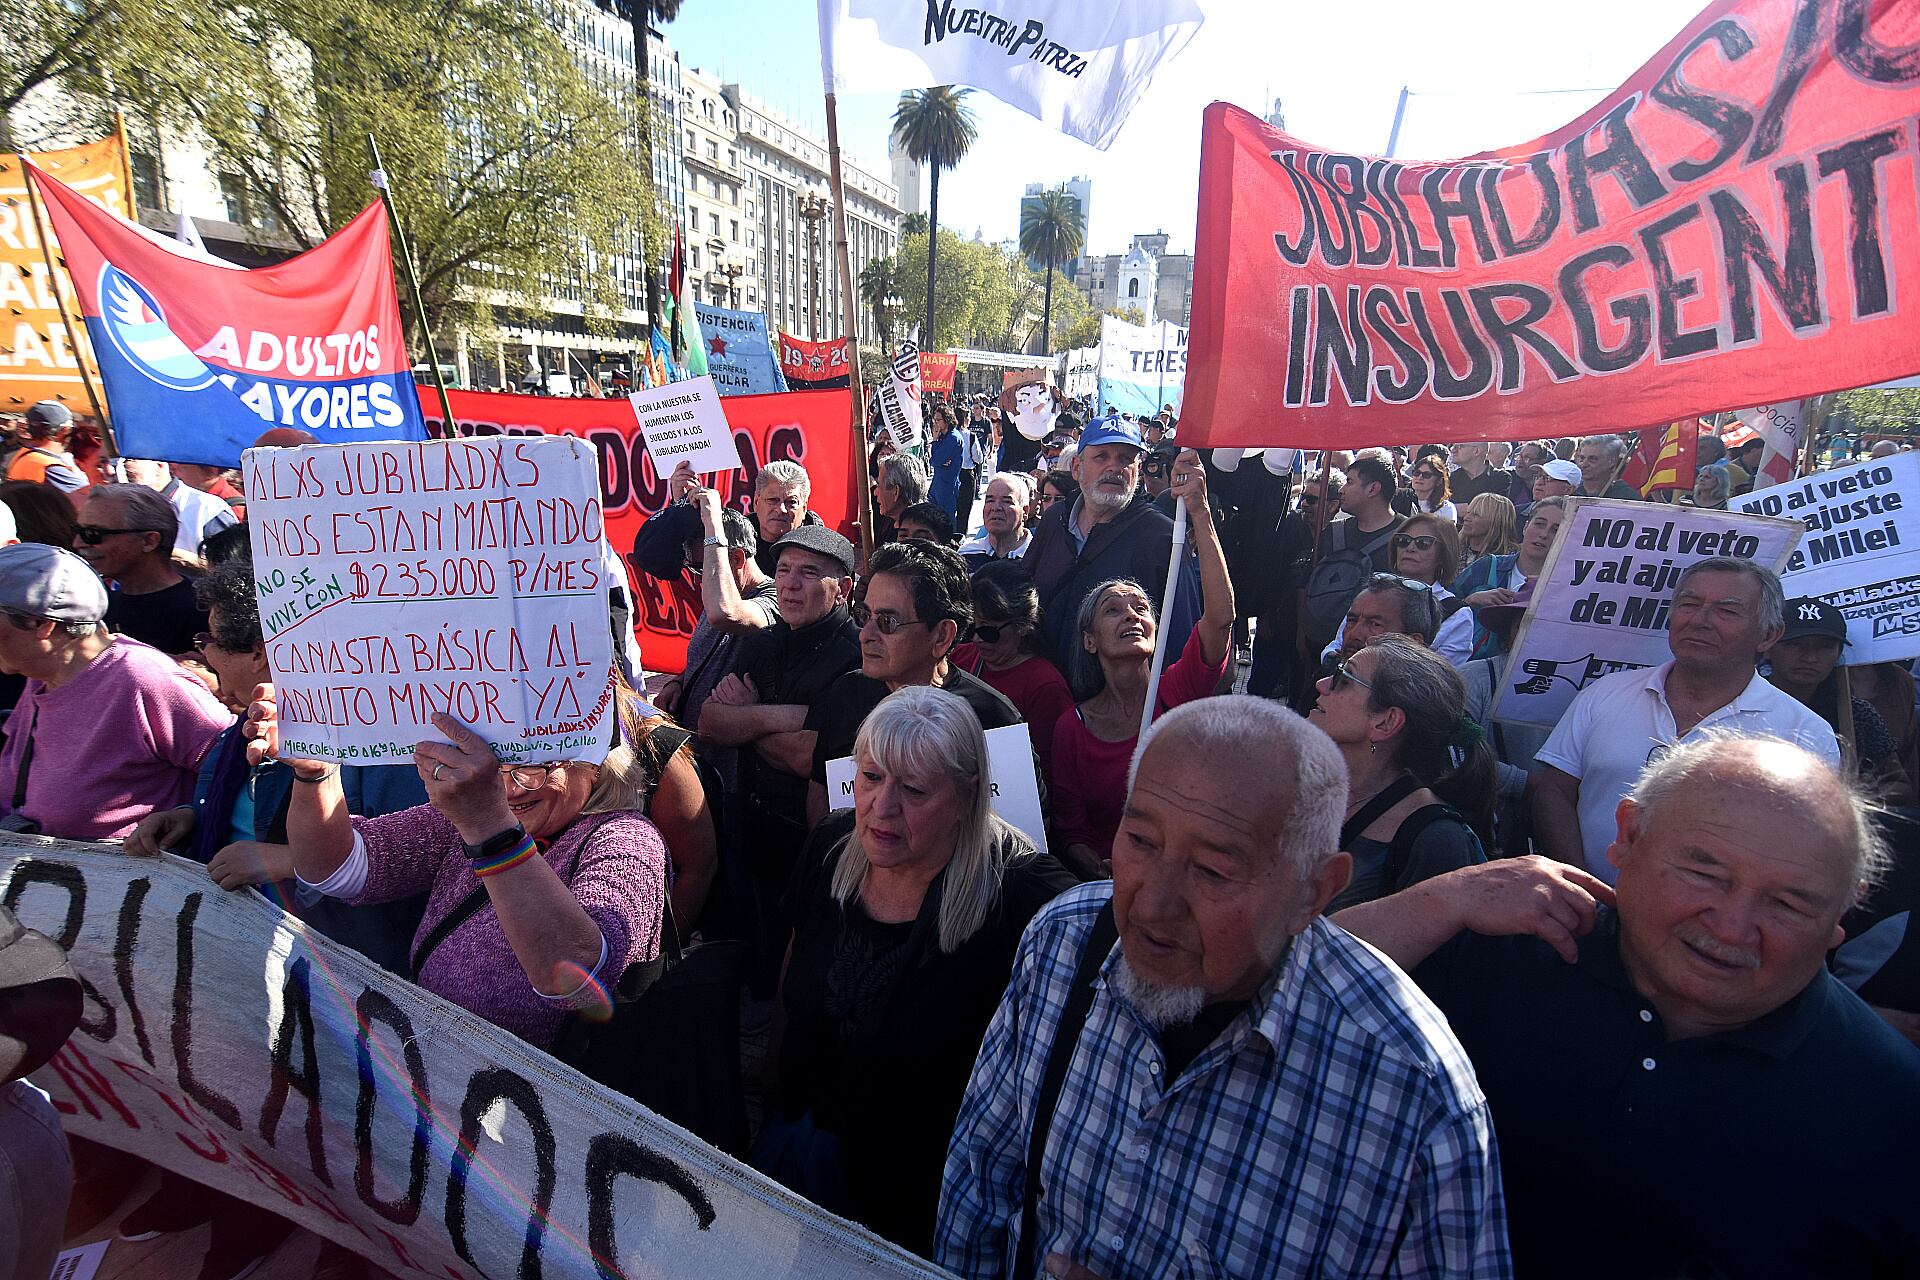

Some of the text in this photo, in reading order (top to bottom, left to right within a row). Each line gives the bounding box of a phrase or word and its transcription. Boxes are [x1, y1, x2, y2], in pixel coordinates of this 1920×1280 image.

[1008, 20, 1088, 79] PATRIA
[1283, 116, 1914, 408] INSURGENT
[193, 325, 381, 377] ADULTOS
[783, 344, 803, 367] 19
[923, 355, 956, 366] MARIA
[638, 392, 702, 414] CON LA NUESTRA SE
[644, 410, 695, 429] AUMENTAN LOS
[884, 400, 915, 445] ZAMORA
[1756, 405, 1800, 442] ocia
[648, 425, 703, 443] SUELDOS Y A LOS
[654, 439, 712, 457] JUBILADOS NADA!
[252, 456, 325, 502] ALXS
[336, 443, 540, 496] JUBILADXS
[1741, 465, 1893, 517] NO al veto
[262, 496, 602, 557] NOS ESTAN MATANDO
[1801, 491, 1903, 533] ajuste
[1582, 518, 1760, 559] NO al veto
[1807, 519, 1901, 566] Milei
[256, 566, 317, 598] NO SE
[350, 552, 599, 598] $235.000 P/MES
[1569, 555, 1690, 593] y al aju
[265, 573, 344, 635] VIVE CON
[1569, 592, 1672, 631] de Mi
[273, 621, 592, 675] CANASTA BÁSICA AL
[281, 686, 378, 726] ADULTO
[388, 680, 516, 725] MAYOR
[520, 720, 586, 738] JUBILADXS
[336, 748, 349, 759] DE
[348, 745, 359, 758] 15
